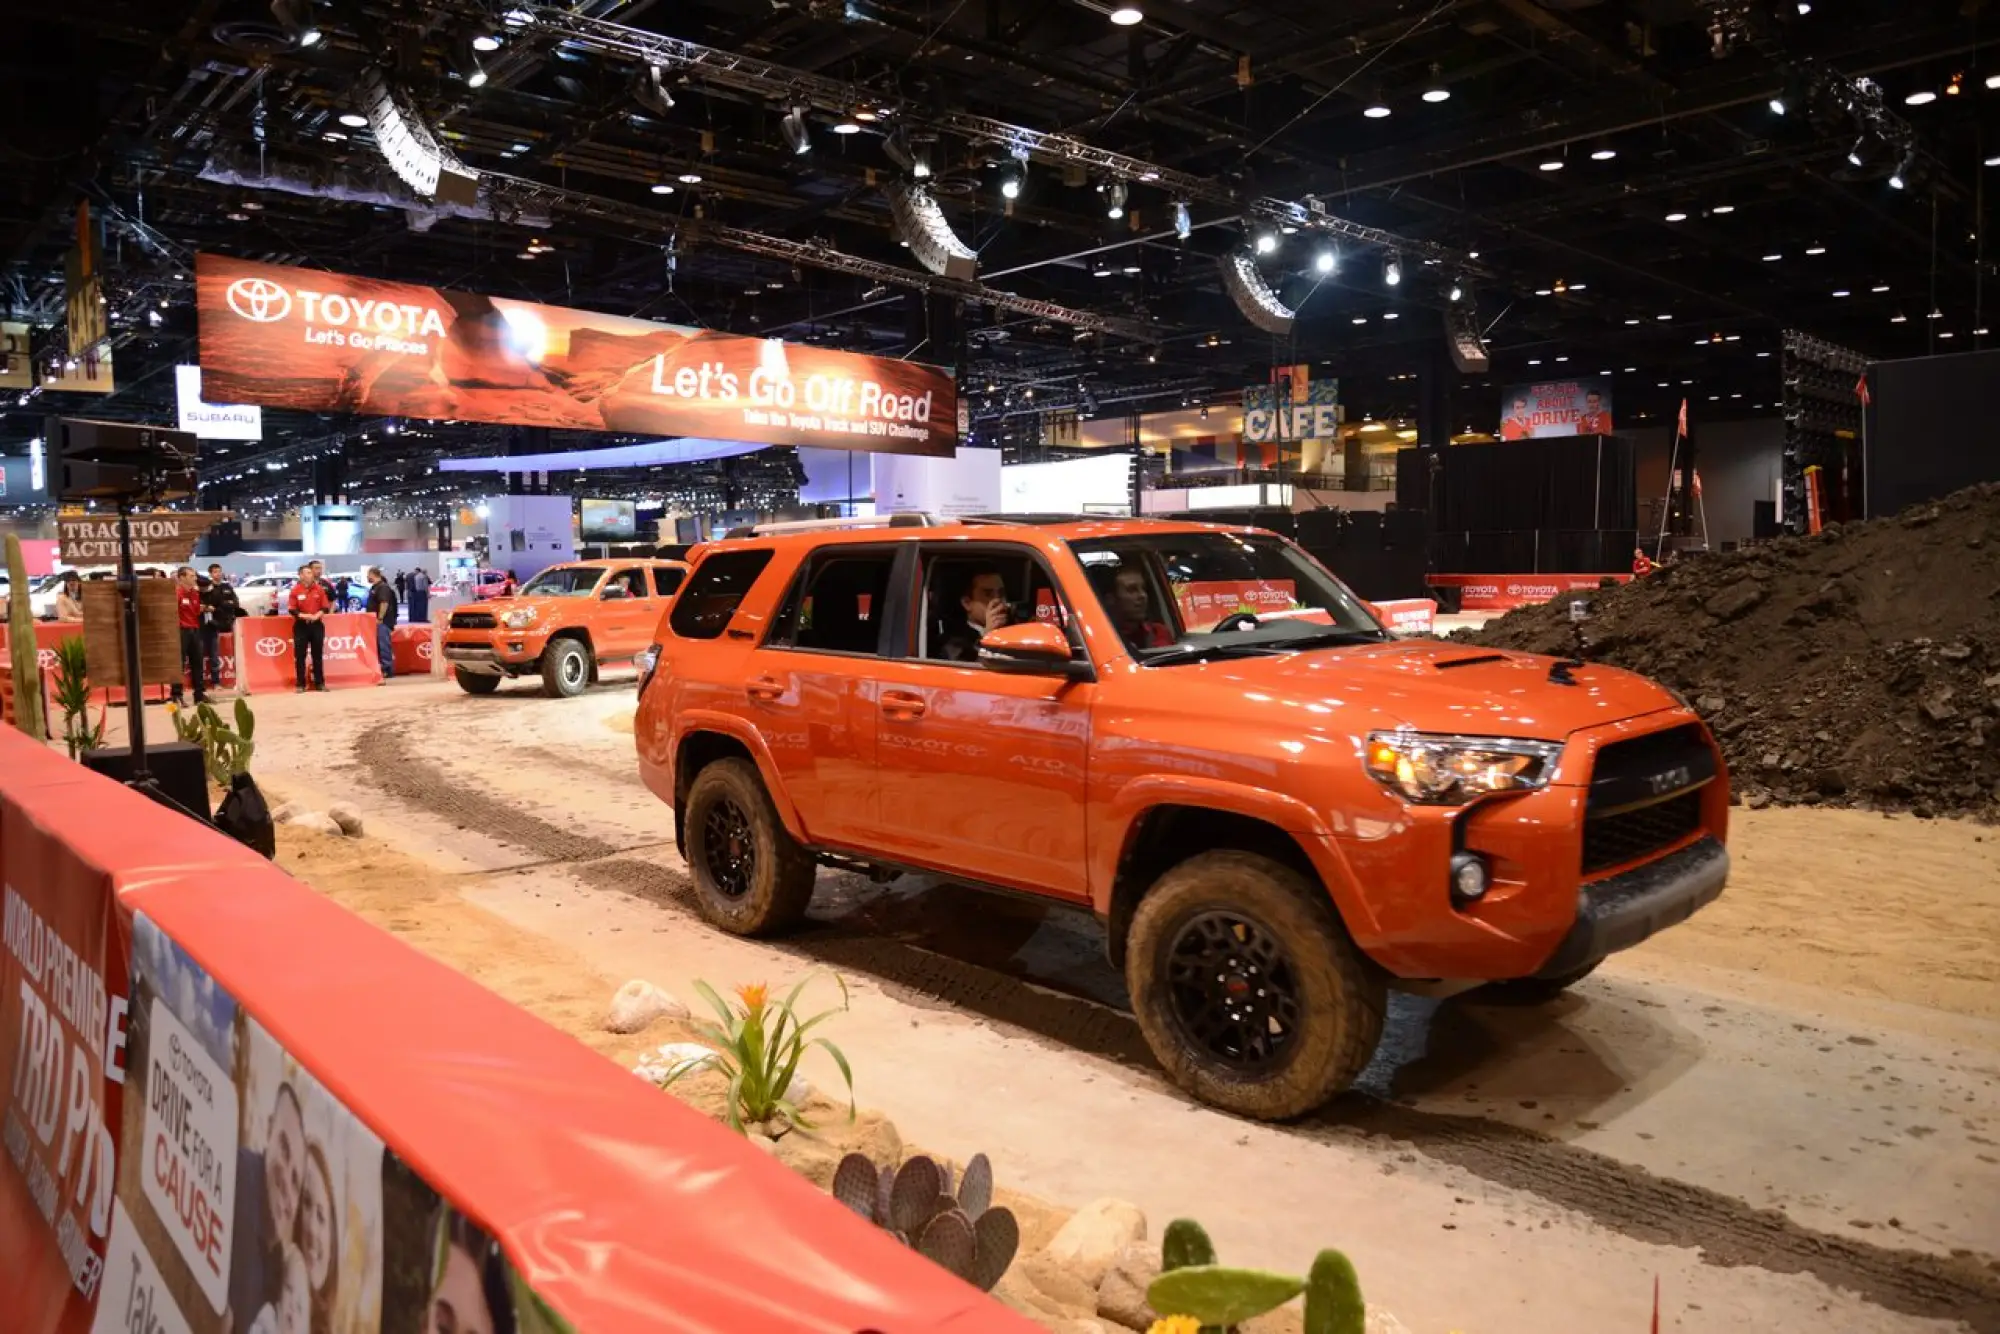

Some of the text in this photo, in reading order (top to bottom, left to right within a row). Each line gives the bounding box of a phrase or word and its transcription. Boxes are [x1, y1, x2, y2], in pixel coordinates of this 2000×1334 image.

[296, 290, 447, 338] TOYOTA
[305, 327, 428, 355] Let's Go Places
[651, 353, 932, 423] Let's Go Off Road
[187, 411, 255, 424] SUBARU
[769, 410, 788, 427] the
[789, 412, 821, 432] Toyota
[869, 422, 887, 435] SUV
[888, 423, 929, 443] Challenge
[1246, 405, 1337, 441] CAFE
[1531, 408, 1581, 426] DRIVE
[63, 520, 180, 537] TRACTION
[1465, 585, 1499, 594] TOYOTA
[1521, 585, 1559, 595] TOYOTA
[3, 882, 43, 983] WORLD
[13, 978, 64, 1146] TRD
[181, 1050, 214, 1109] TOYOTA
[153, 1057, 223, 1205] DRIVE FOR A
[154, 1132, 225, 1279] CAUSE
